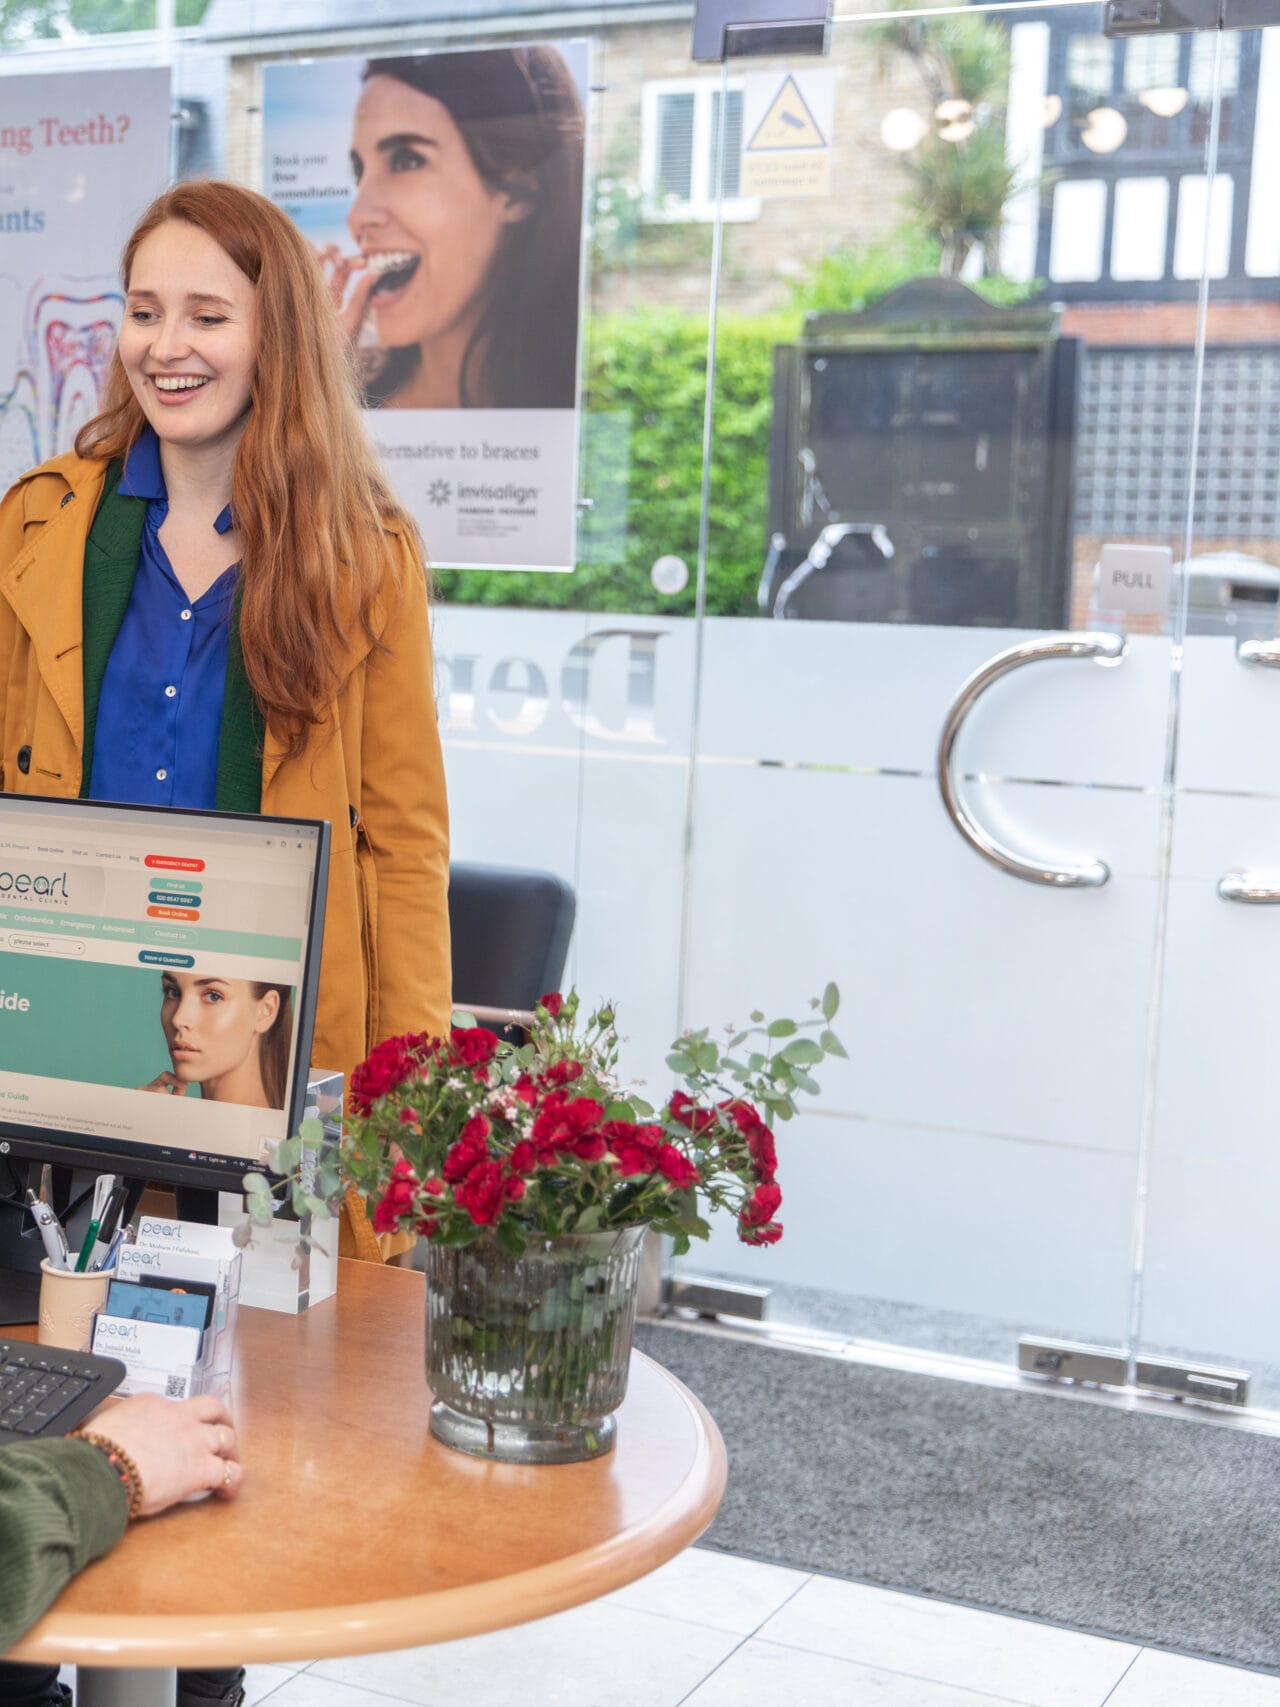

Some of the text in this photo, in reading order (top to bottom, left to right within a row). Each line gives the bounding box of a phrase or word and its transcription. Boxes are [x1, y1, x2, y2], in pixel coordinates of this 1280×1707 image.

[39, 113, 130, 148] Teeth?
[377, 440, 540, 460] ternative to braces
[457, 482, 539, 504] invisalign
[1112, 570, 1155, 589] PULL
[1, 893, 69, 906] DENTAL CLINIC
[14, 914, 54, 925] Orthodontics
[60, 919, 96, 931] Emergency
[102, 924, 136, 934] Advanced
[13, 939, 49, 948] please select
[7, 1091, 29, 1101] Guide
[142, 1222, 182, 1238] pearl
[121, 1250, 161, 1266] pearl
[97, 1322, 138, 1338] pearl
